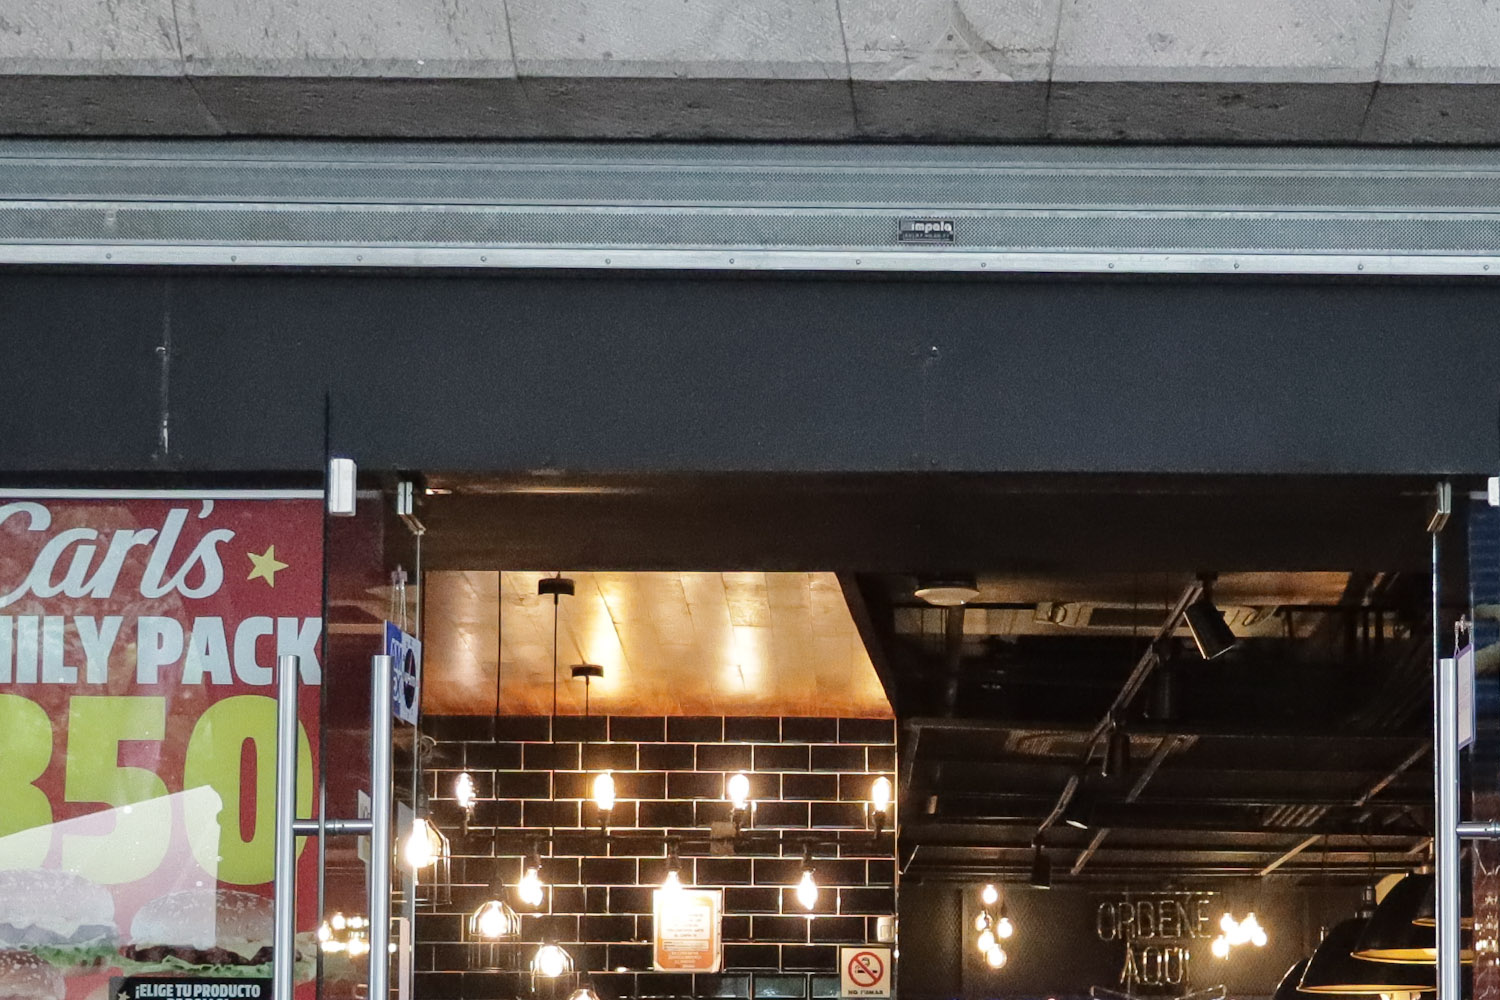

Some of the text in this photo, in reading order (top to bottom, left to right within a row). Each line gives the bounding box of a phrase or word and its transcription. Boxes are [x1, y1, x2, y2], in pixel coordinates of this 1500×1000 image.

[911, 220, 952, 233] impala
[137, 615, 323, 686] PACK
[1097, 901, 1211, 941] ORDENE
[135, 984, 261, 999] ¡ELIGE TU PRODUCTO
